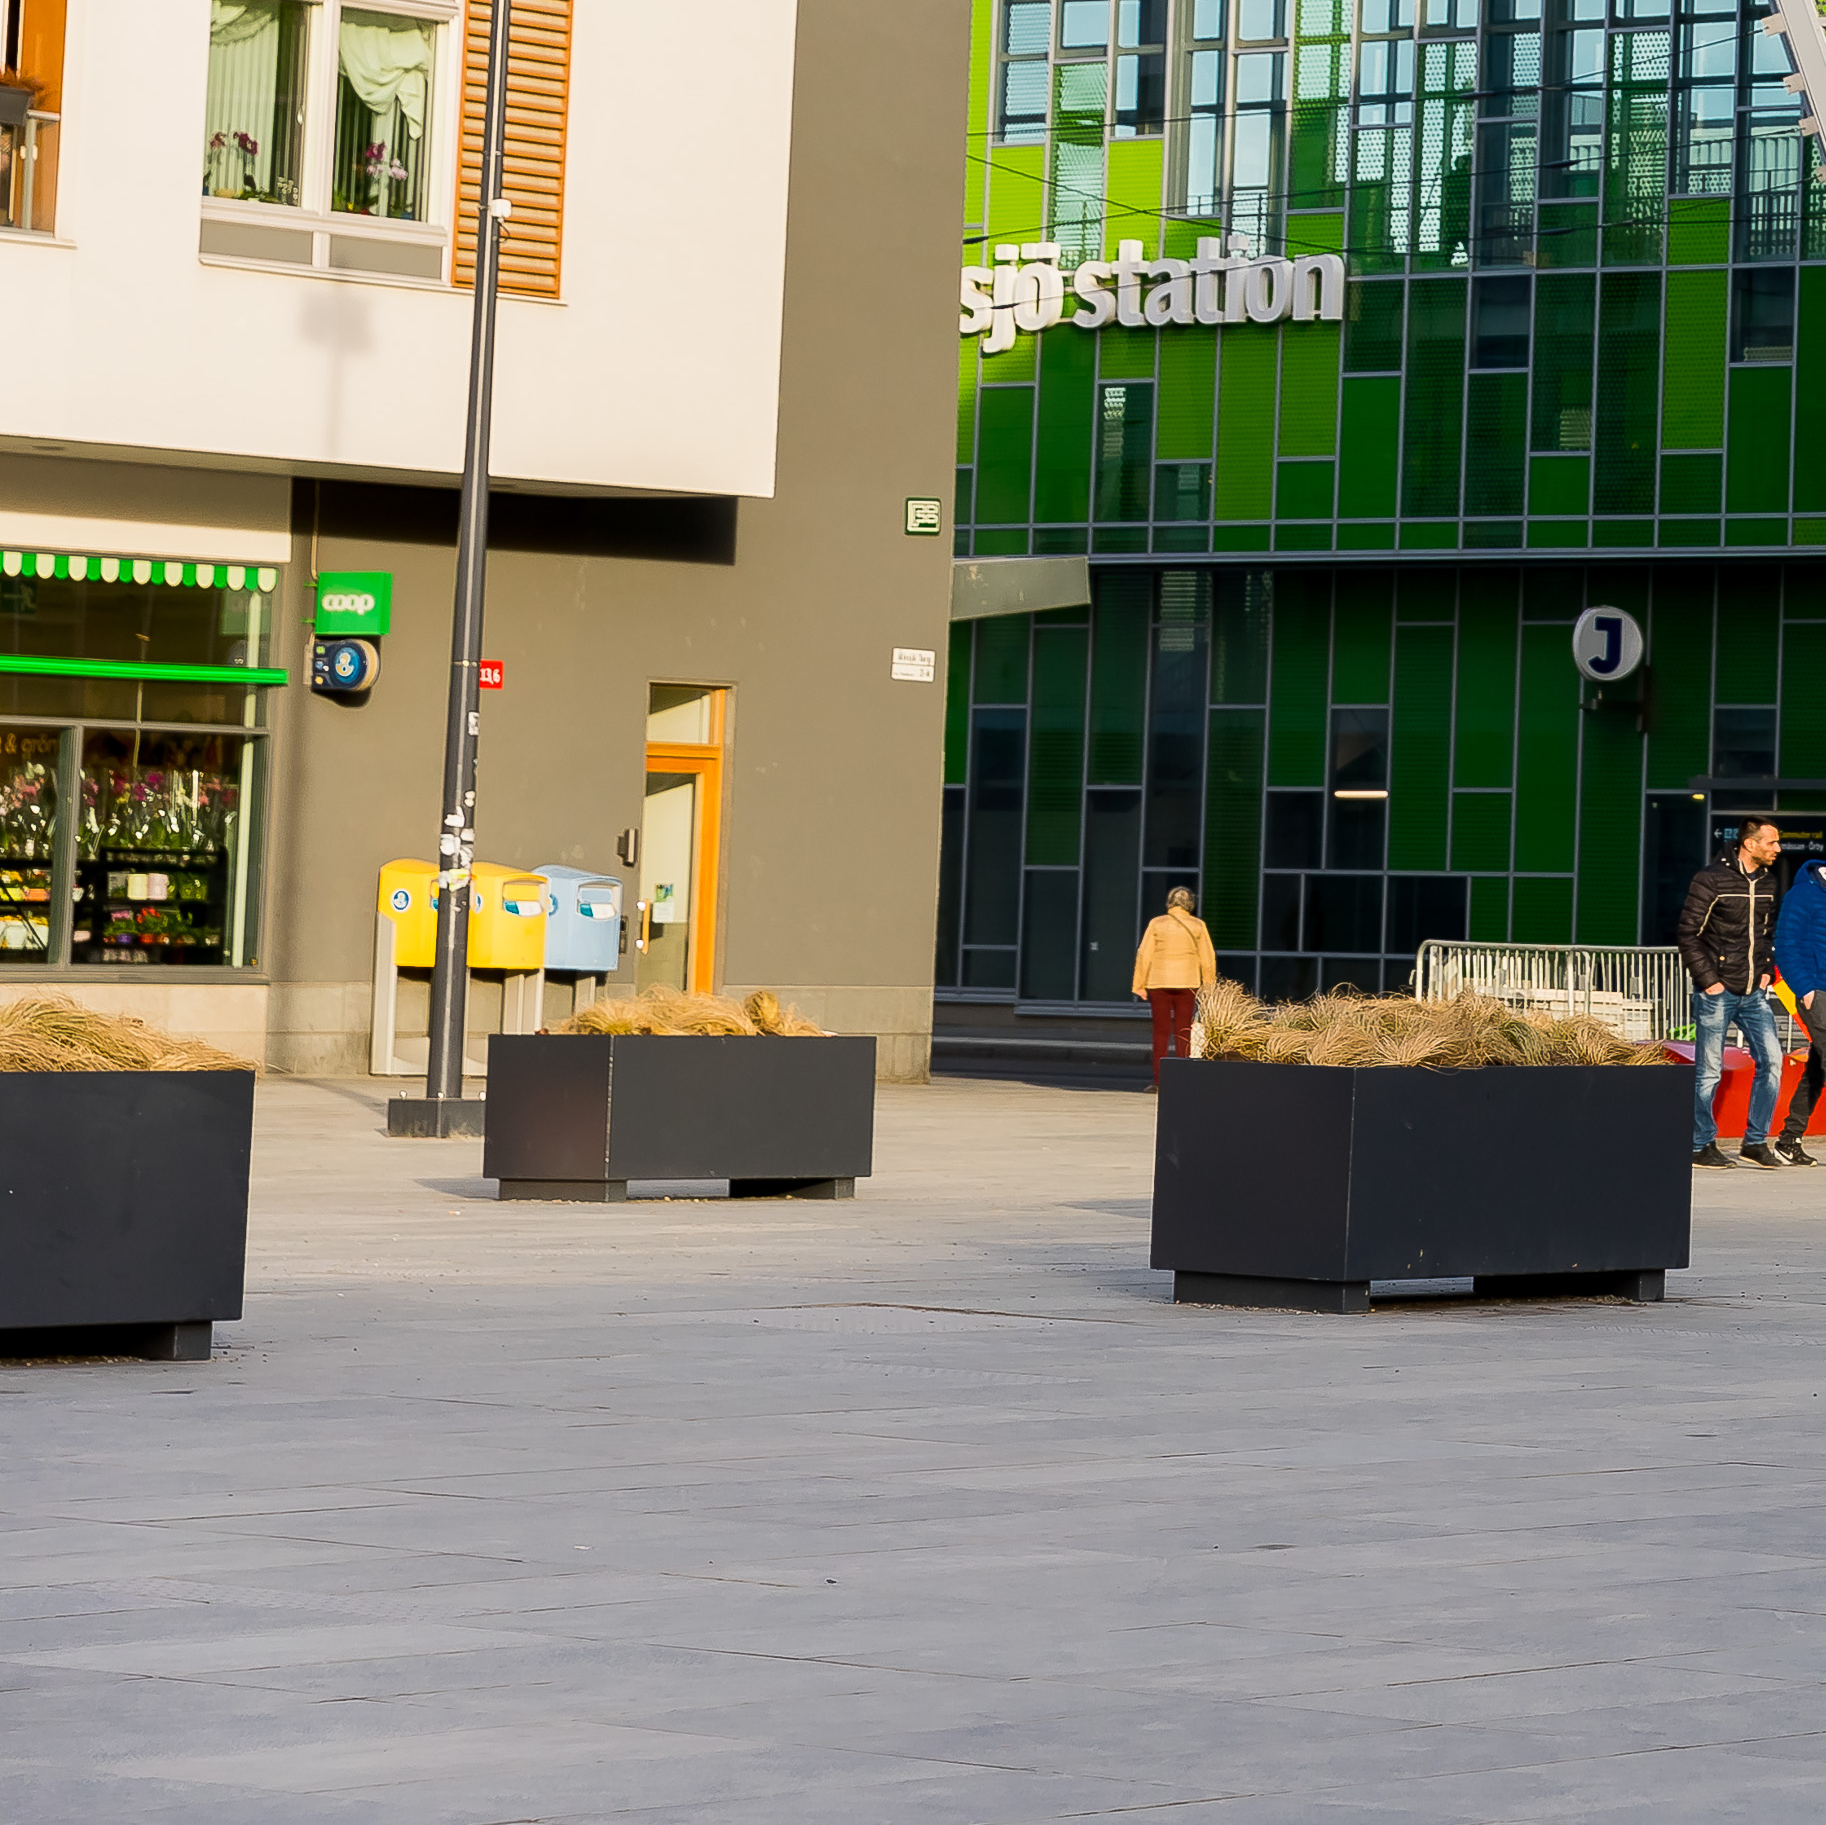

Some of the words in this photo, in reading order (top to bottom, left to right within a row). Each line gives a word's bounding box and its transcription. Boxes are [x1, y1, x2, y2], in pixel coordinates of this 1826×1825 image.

[958, 242, 1065, 354] sjö
[1073, 236, 1346, 329] station
[321, 593, 375, 615] coop
[1587, 616, 1623, 675] J
